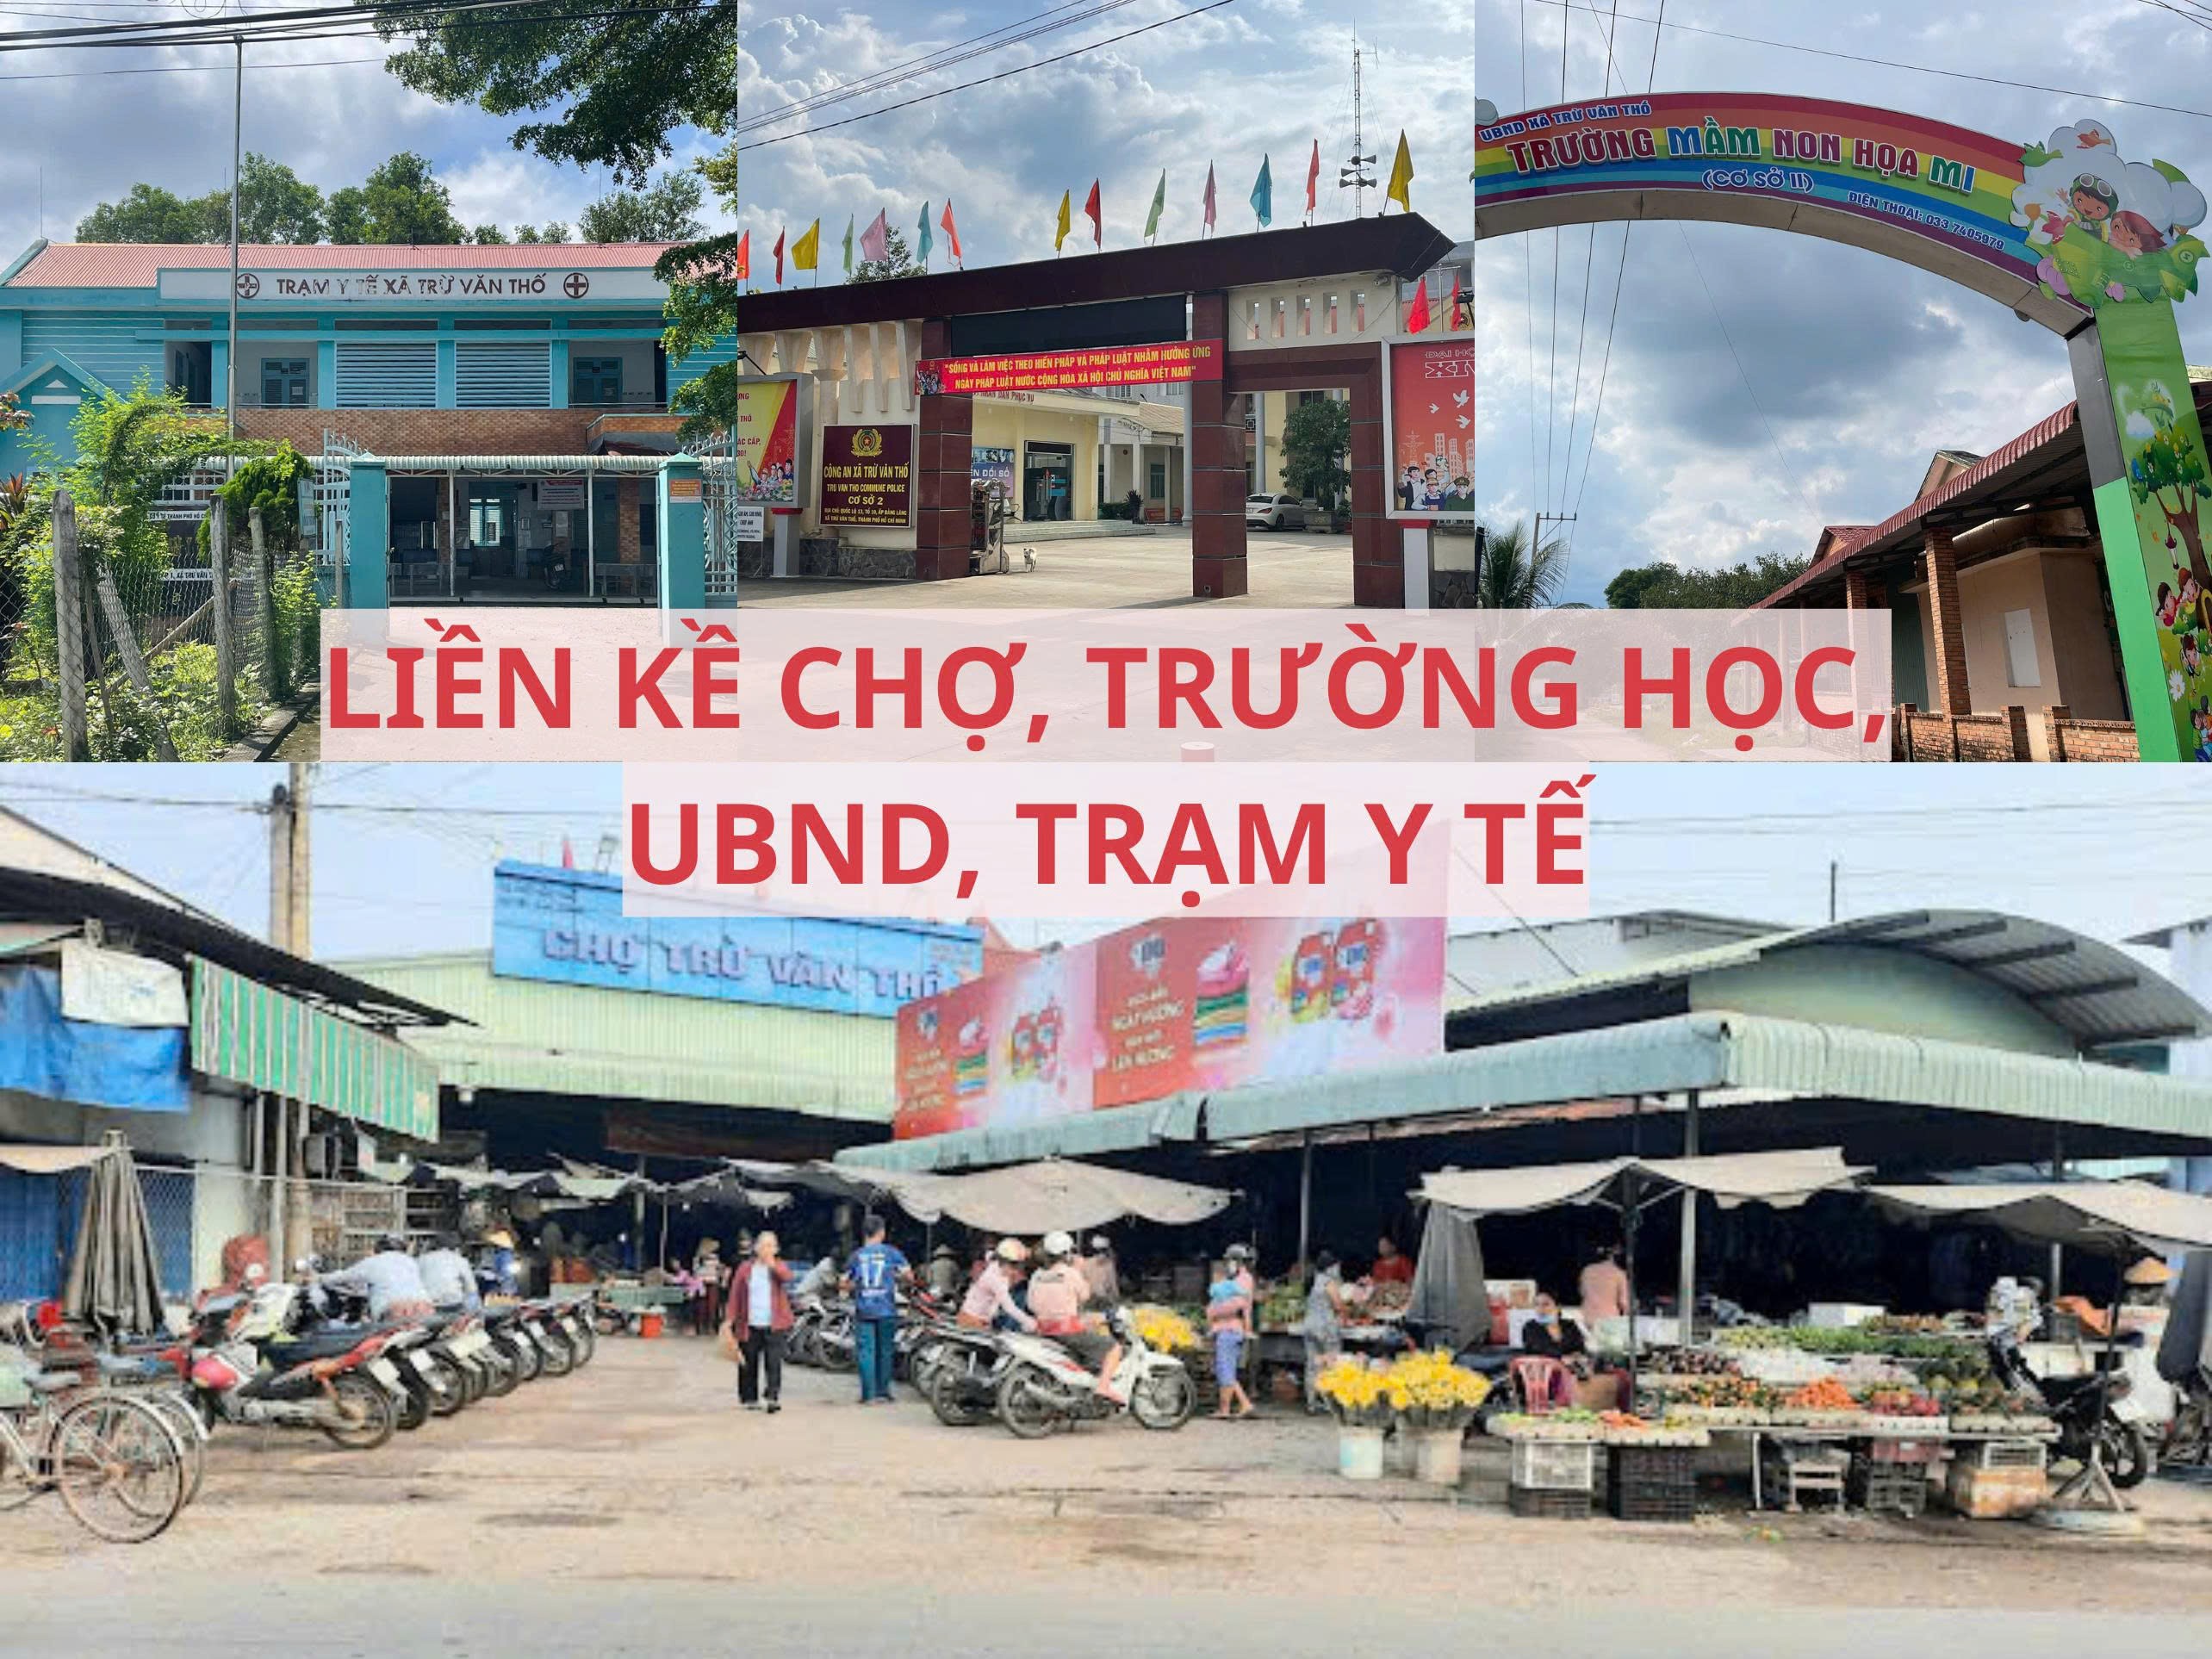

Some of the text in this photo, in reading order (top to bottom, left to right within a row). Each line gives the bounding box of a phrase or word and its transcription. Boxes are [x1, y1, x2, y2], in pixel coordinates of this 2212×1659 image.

[1479, 100, 1652, 142] UBND XÃ TRỪ VĂN THỐ
[1506, 116, 1977, 196] TRƯỜNG MẦM NON HỌA MI
[1701, 166, 1815, 194] (CƠ SỞ II)
[1847, 190, 2006, 252] ĐIỆN THOẠI: 033 7405979
[276, 272, 548, 296] TRẠM Y TẾ XÃ TRỪ VĂN THỐ
[969, 360, 979, 372] VÀ
[980, 359, 995, 372] LÀM
[997, 357, 1013, 372] VIỆC
[1015, 359, 1033, 370] THEO
[1035, 356, 1053, 369] HIẾN
[1054, 356, 1075, 368] PHÁP
[1077, 354, 1087, 366] VÀ
[1089, 352, 1110, 365] PHÁP
[1112, 351, 1132, 366] LUẬT
[1192, 345, 1211, 358] ỨNG
[955, 377, 974, 389] NGÀY
[975, 377, 994, 388] PHÁP
[996, 375, 1013, 388] LUẬT
[1037, 374, 1059, 387] CỘNG
[1077, 370, 1088, 382] XÃ
[1090, 370, 1103, 384] HỘI
[1123, 367, 1149, 381] NGHĨA
[1152, 365, 1168, 381] VIỆT
[824, 462, 910, 478] CÔNG AN XÃ TRỪ VĂN THỐ
[848, 494, 884, 506] CƠ SỞ 2
[886, 484, 905, 493] POLICE
[544, 928, 638, 974] CHỢ
[661, 934, 749, 980] TRỪ
[767, 950, 854, 994] VĂN
[859, 1258, 885, 1288] 17
